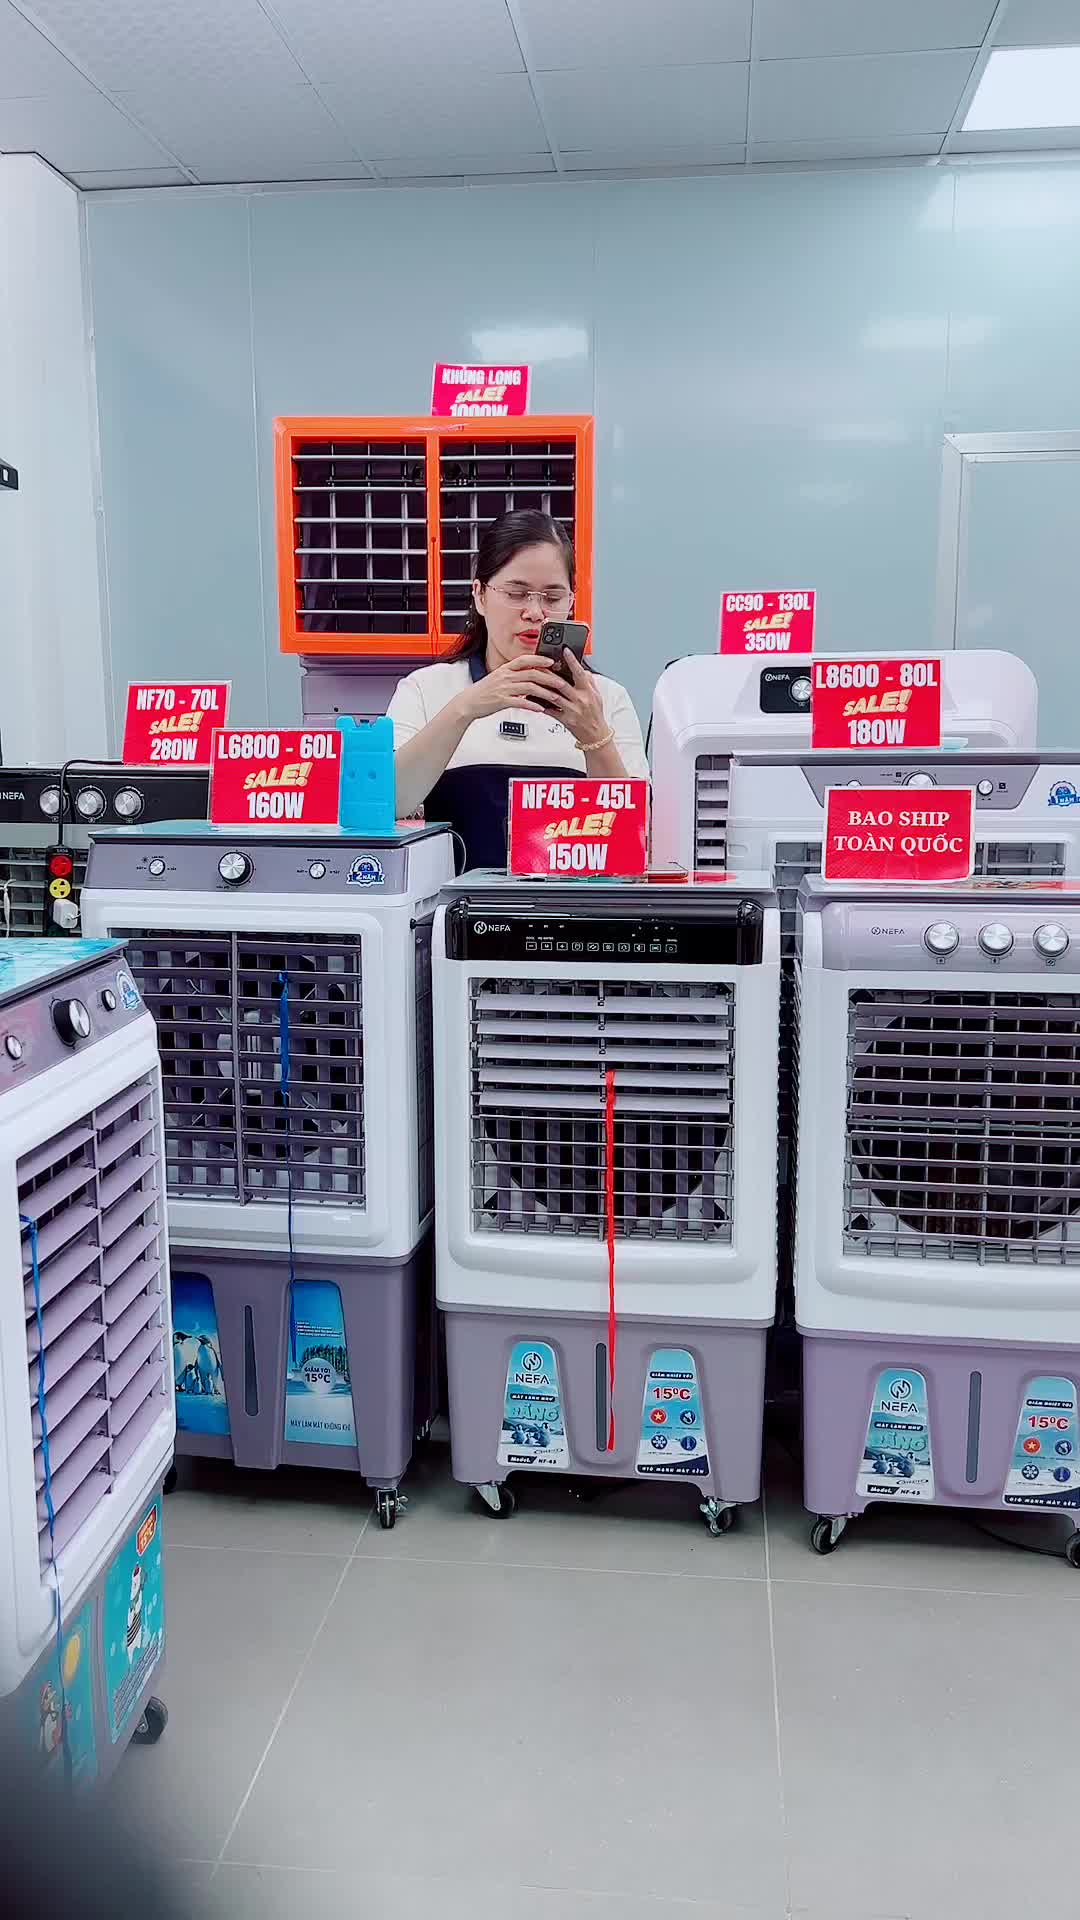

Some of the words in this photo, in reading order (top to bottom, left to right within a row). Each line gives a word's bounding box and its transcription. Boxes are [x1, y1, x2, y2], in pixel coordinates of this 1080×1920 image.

[488, 370, 522, 386] LONG
[450, 404, 508, 416] 1000W
[726, 594, 763, 612] CC90
[778, 593, 811, 610] 130L
[743, 612, 794, 632] SALE!
[745, 632, 792, 651] 350W
[816, 664, 880, 688] L8600
[900, 663, 938, 687] 80L
[136, 688, 176, 710] NF70
[190, 688, 219, 710] 70L
[842, 688, 912, 717] SALE!
[148, 710, 204, 735] SALE!
[848, 719, 906, 744] 180W
[150, 738, 198, 760] 280W
[218, 734, 280, 760] L6800
[300, 734, 336, 759] 60L
[242, 762, 314, 790] SALE!
[2, 792, 25, 800] NEFA
[246, 791, 304, 818] 160W
[522, 784, 575, 809] NF45
[596, 784, 636, 809] 45L
[544, 811, 616, 840] SALE!
[848, 810, 893, 826] BAO
[898, 811, 950, 826] SHIP
[834, 832, 896, 852] TOÀN
[900, 832, 964, 856] QUỐC
[546, 843, 608, 870] 150W
[516, 1373, 550, 1384] NEFA
[882, 1400, 918, 1413] NEFA
